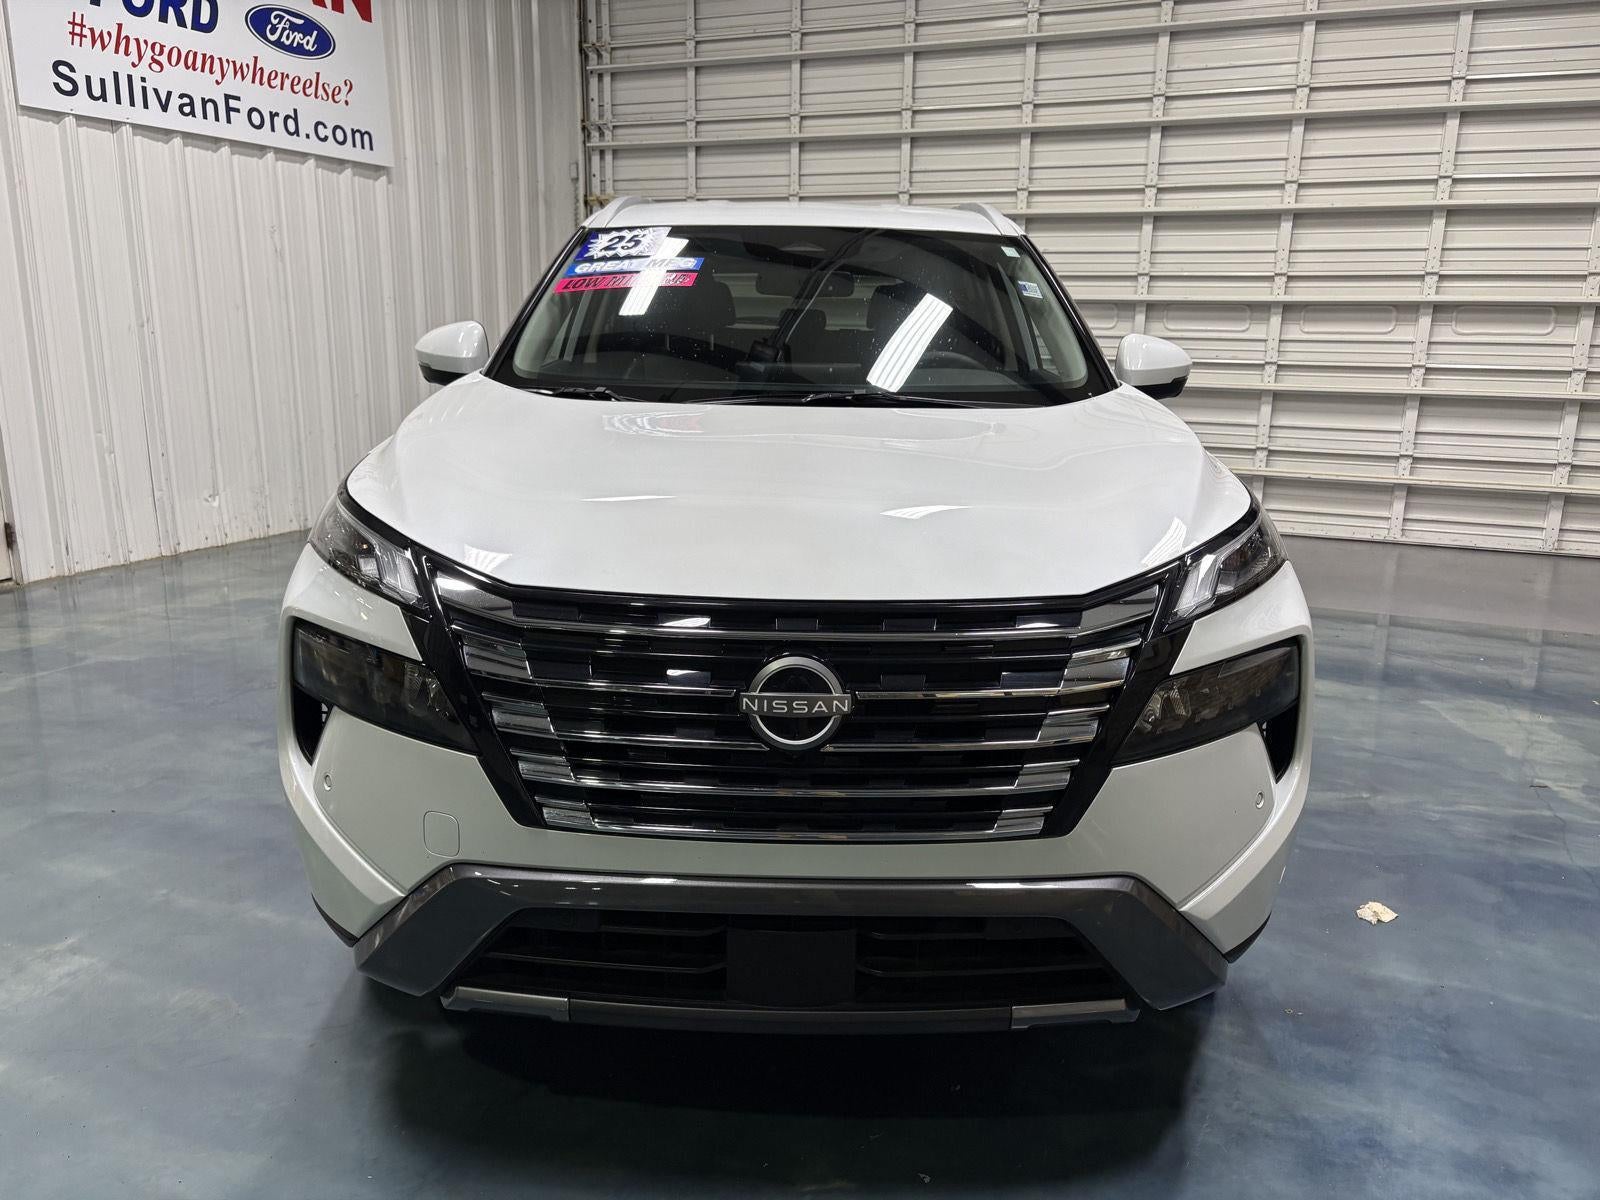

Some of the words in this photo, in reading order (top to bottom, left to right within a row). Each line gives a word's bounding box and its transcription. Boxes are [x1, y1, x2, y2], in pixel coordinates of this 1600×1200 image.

[90, 0, 218, 34] RD
[266, 11, 318, 54] Ford
[68, 11, 354, 107] #whygoanywhereelse?
[52, 60, 375, 152] SullivanFord.com
[599, 234, 646, 253] 25
[575, 259, 646, 275] GREA
[562, 276, 608, 291] LOW
[742, 697, 848, 714] NISSAN
